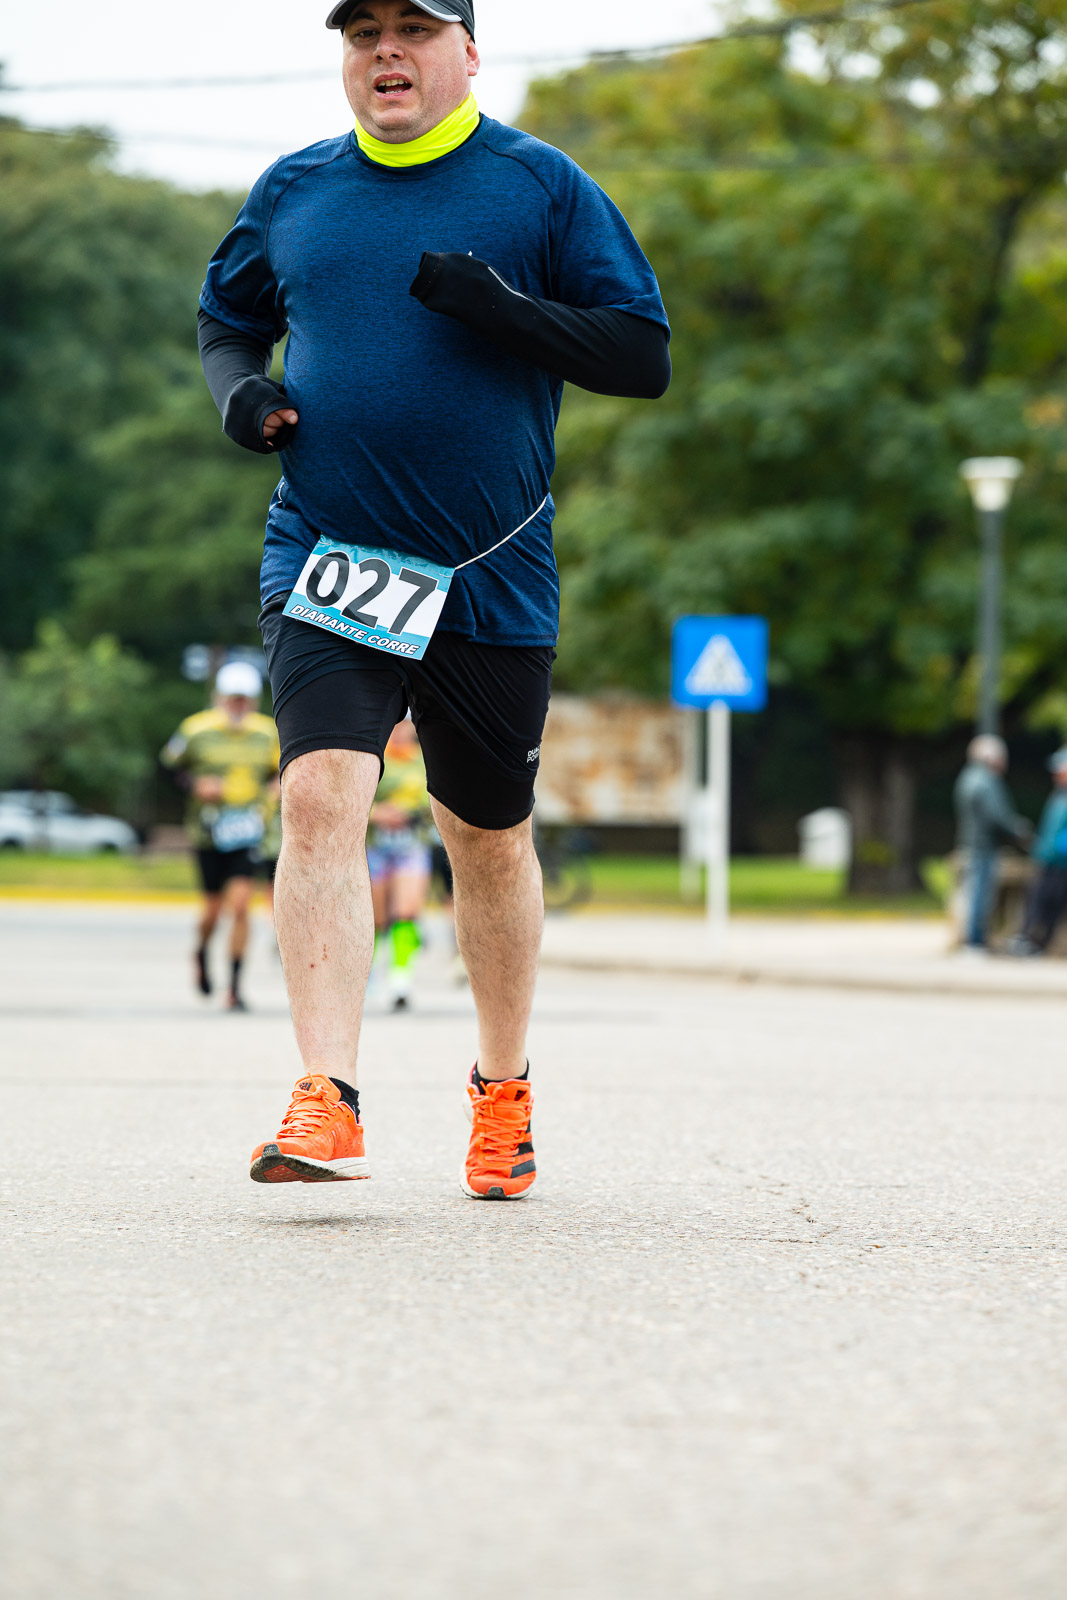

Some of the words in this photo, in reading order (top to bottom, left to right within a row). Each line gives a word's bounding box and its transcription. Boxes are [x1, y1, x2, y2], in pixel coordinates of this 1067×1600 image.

[305, 551, 439, 636] 027
[290, 604, 369, 640] DIAMANTE
[366, 635, 421, 655] CORRE
